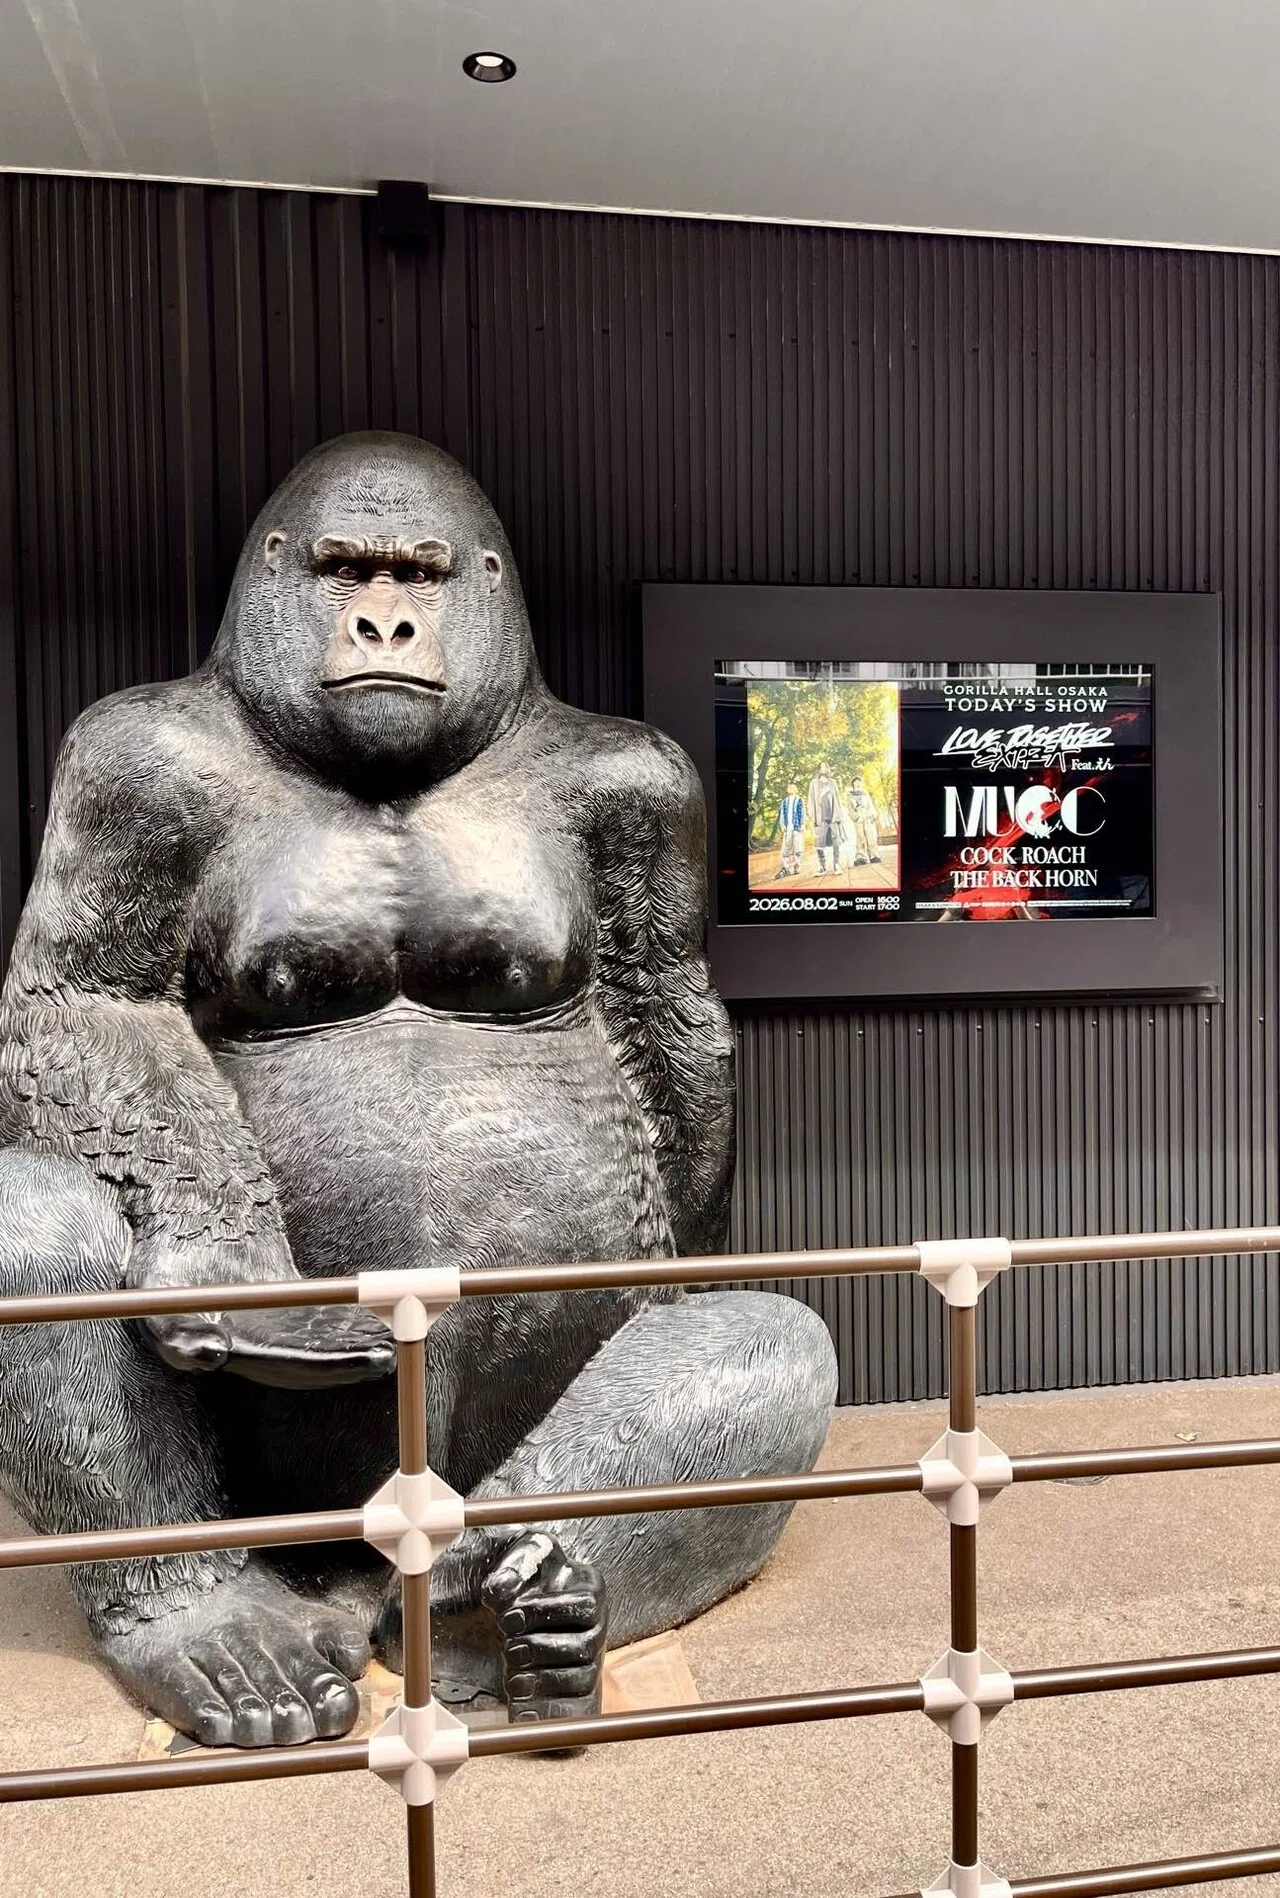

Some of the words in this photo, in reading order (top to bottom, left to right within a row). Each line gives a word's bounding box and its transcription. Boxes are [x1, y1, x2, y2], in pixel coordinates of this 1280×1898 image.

[943, 685, 1008, 696] GORILLA
[1014, 686, 1052, 696] HALL
[1057, 686, 1108, 697] OSAKA
[945, 698, 1036, 712] TODAY'S
[1045, 698, 1108, 713] SHOW
[938, 725, 1005, 753] LOVE
[1006, 722, 1114, 750] TOGETHER
[943, 784, 1106, 839] MUCC
[960, 846, 1016, 865] COCK
[1021, 845, 1086, 864] ROACH
[950, 870, 989, 888] THE
[992, 869, 1044, 888] BACK
[1045, 869, 1098, 887] HORN
[749, 897, 838, 911] 2026.08.02
